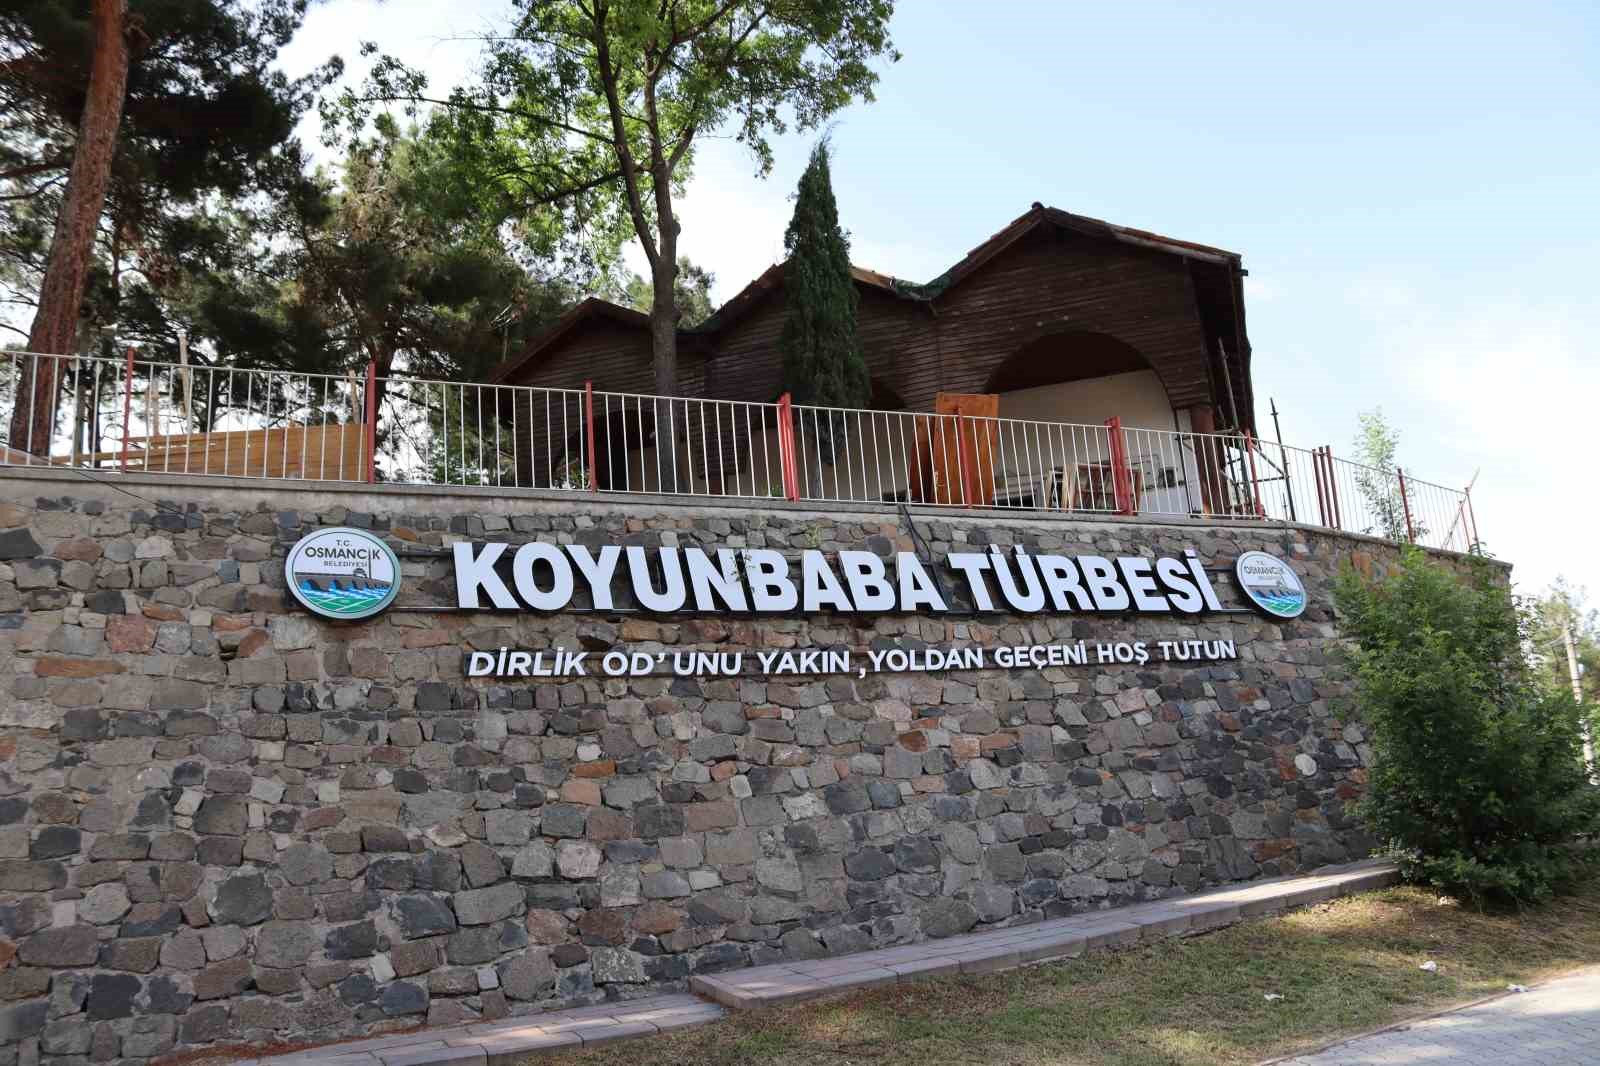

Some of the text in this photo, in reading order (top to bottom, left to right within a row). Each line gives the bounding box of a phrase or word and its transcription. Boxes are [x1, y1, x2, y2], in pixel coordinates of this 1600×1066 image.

[452, 541, 1222, 613] KOYUNBABA TÜRBESİ
[468, 647, 588, 677] DİRLİK
[994, 640, 1089, 670] GEÇENİ
[1098, 641, 1150, 667] HOŞ
[1157, 639, 1236, 661] TUTUN
